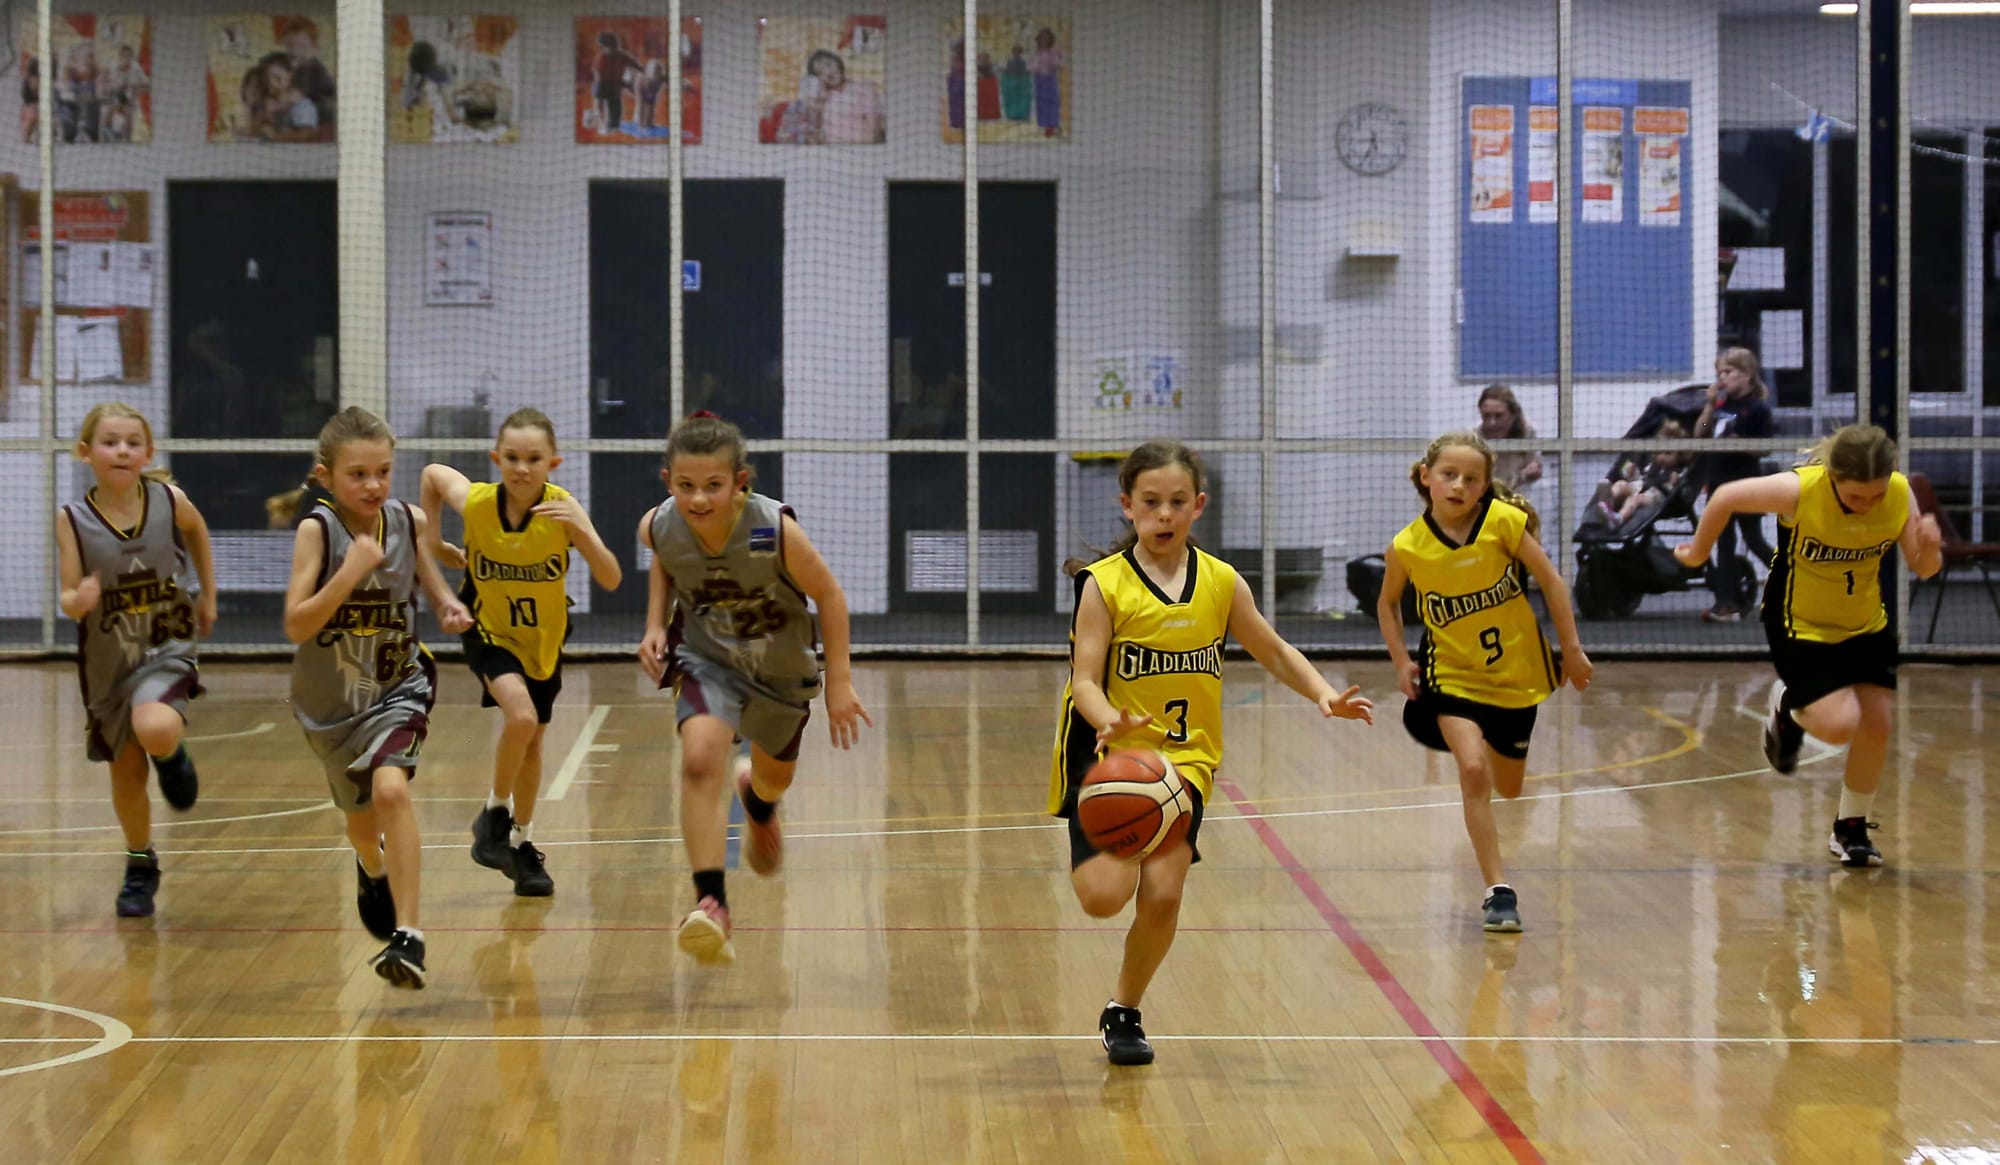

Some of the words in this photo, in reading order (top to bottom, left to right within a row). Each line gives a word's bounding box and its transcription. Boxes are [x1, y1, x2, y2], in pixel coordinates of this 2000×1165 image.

[475, 551, 563, 581] GADIATOS
[1801, 537, 1892, 562] GLADIATS
[1426, 565, 1521, 629] GLADIATORS
[1843, 570, 1855, 596] 1
[151, 604, 193, 646] 63
[506, 595, 538, 628] 10
[735, 600, 787, 638] 25
[376, 637, 419, 684] 62
[1117, 637, 1222, 681] GLADIATORS
[1479, 626, 1504, 666] 9
[1164, 698, 1189, 743] 3
